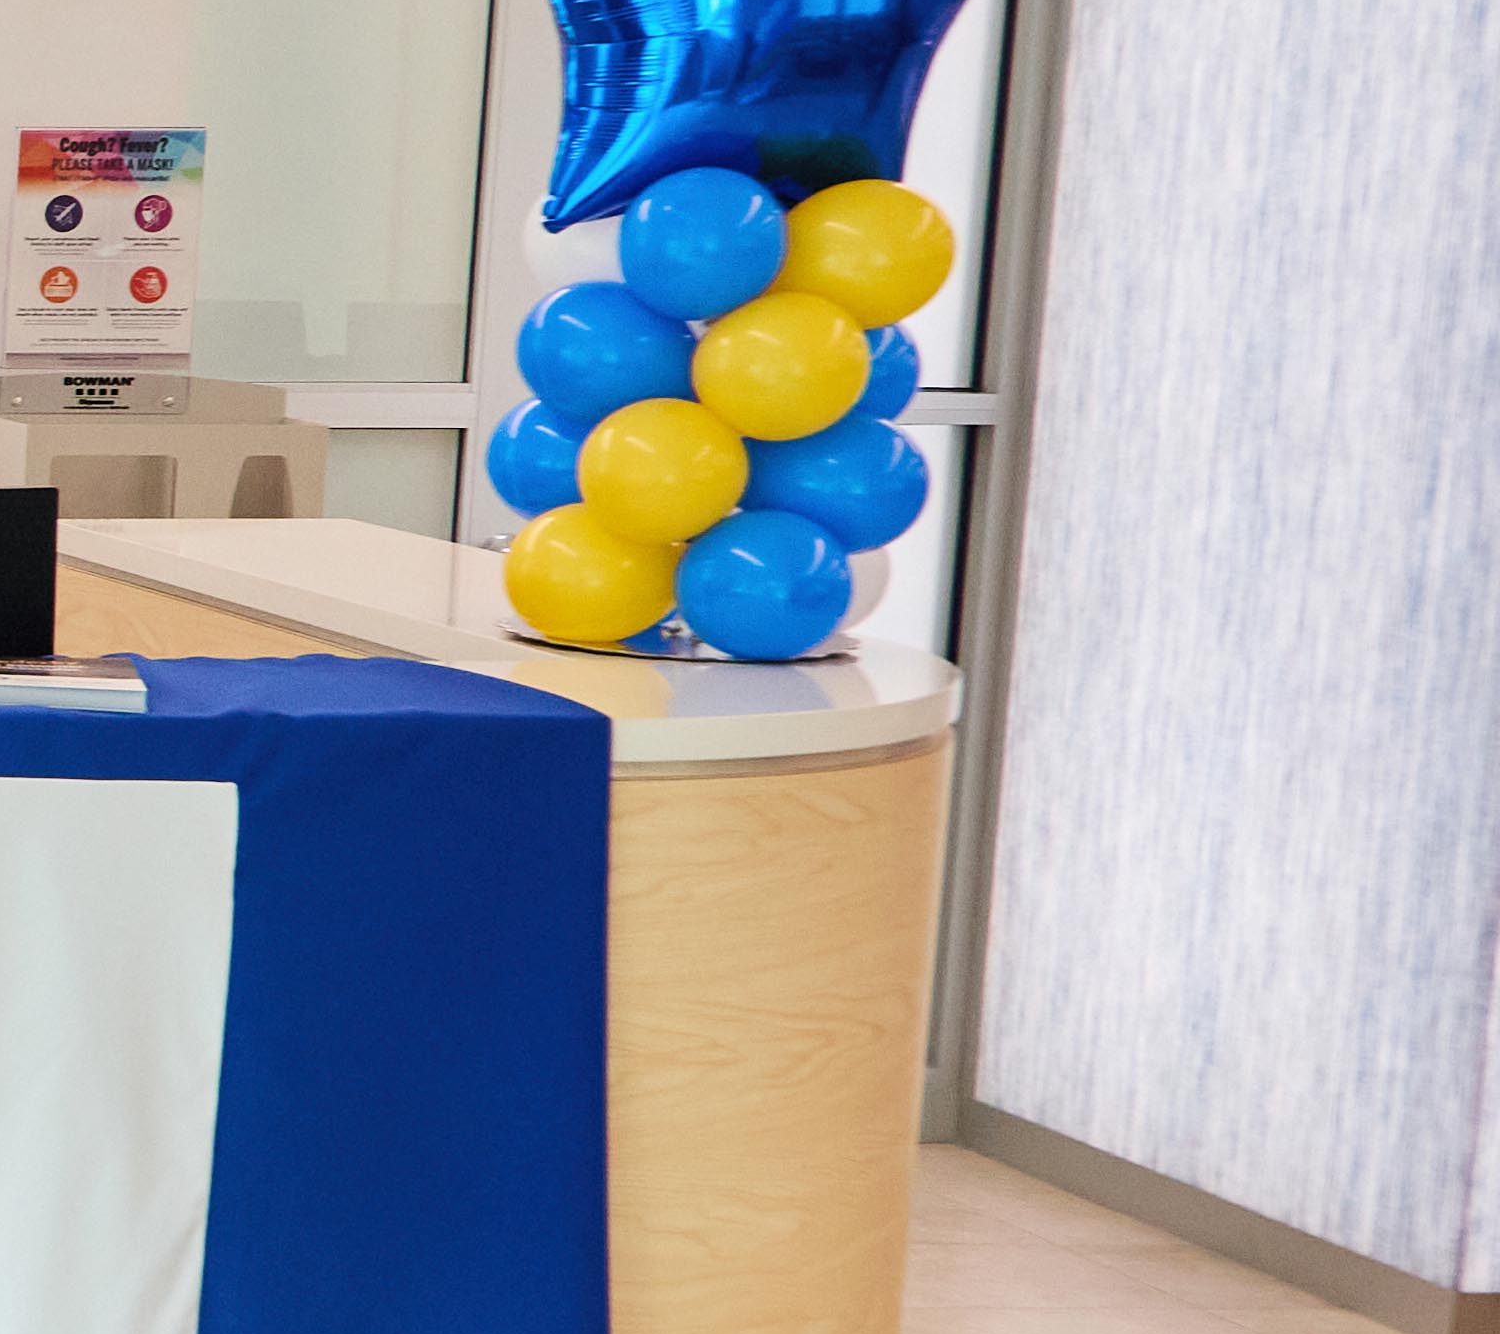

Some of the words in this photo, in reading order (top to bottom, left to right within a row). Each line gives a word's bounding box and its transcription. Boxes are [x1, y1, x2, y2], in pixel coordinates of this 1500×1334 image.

[60, 137, 114, 156] Cough?
[120, 137, 169, 153] Fever?
[52, 158, 93, 171] PLEASE
[97, 158, 125, 171] TAKE
[128, 159, 135, 170] A
[137, 158, 174, 171] MASK!
